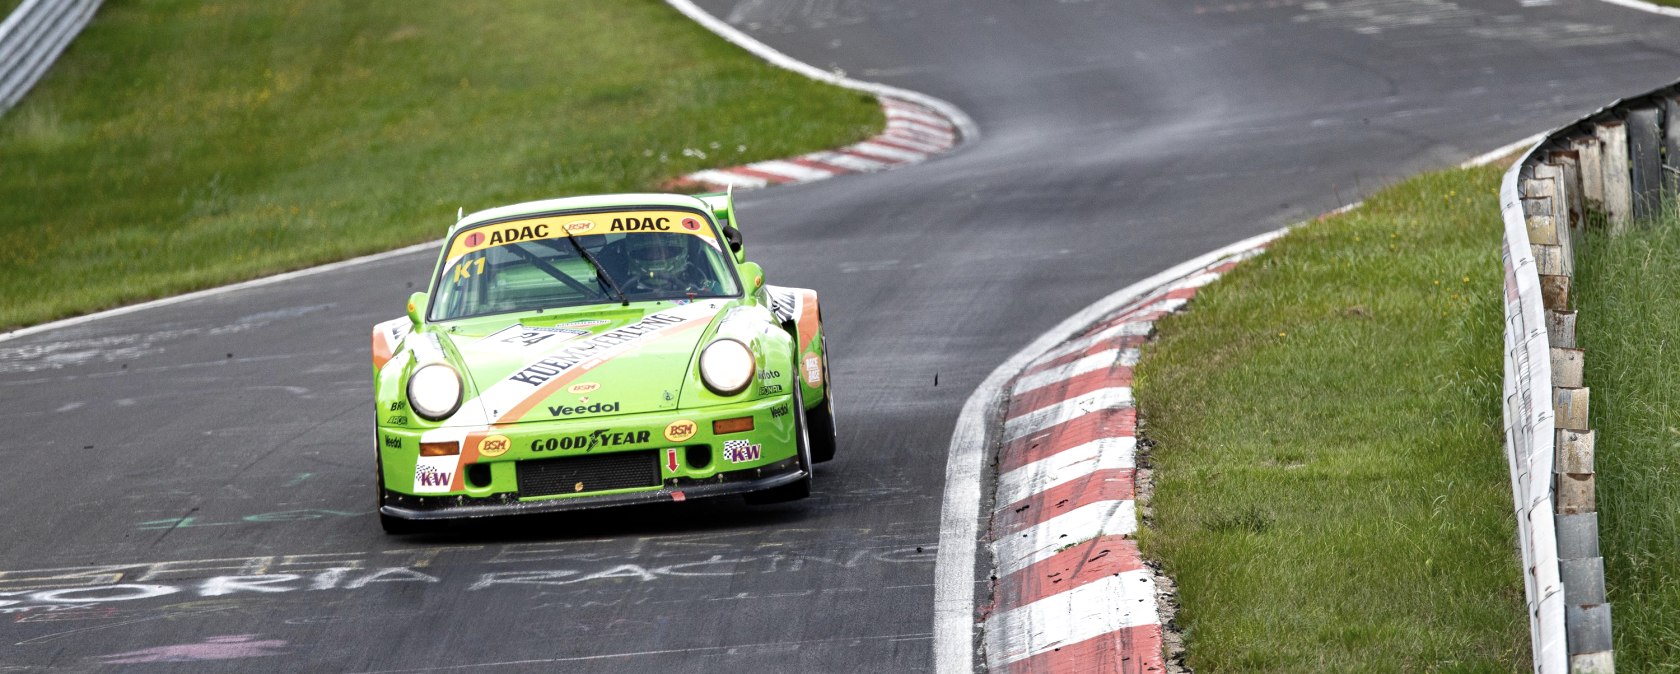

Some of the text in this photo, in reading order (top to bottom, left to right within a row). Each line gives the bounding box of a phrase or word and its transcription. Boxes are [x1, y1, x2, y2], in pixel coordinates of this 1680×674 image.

[610, 216, 671, 231] ADAC
[489, 223, 550, 245] ADAC
[454, 256, 486, 284] K1
[509, 313, 687, 387] KUEMMERLING
[548, 401, 619, 417] Veedol
[670, 424, 693, 435] BSM
[483, 439, 507, 451] BSM
[731, 445, 761, 463] KW
[421, 472, 451, 487] KW
